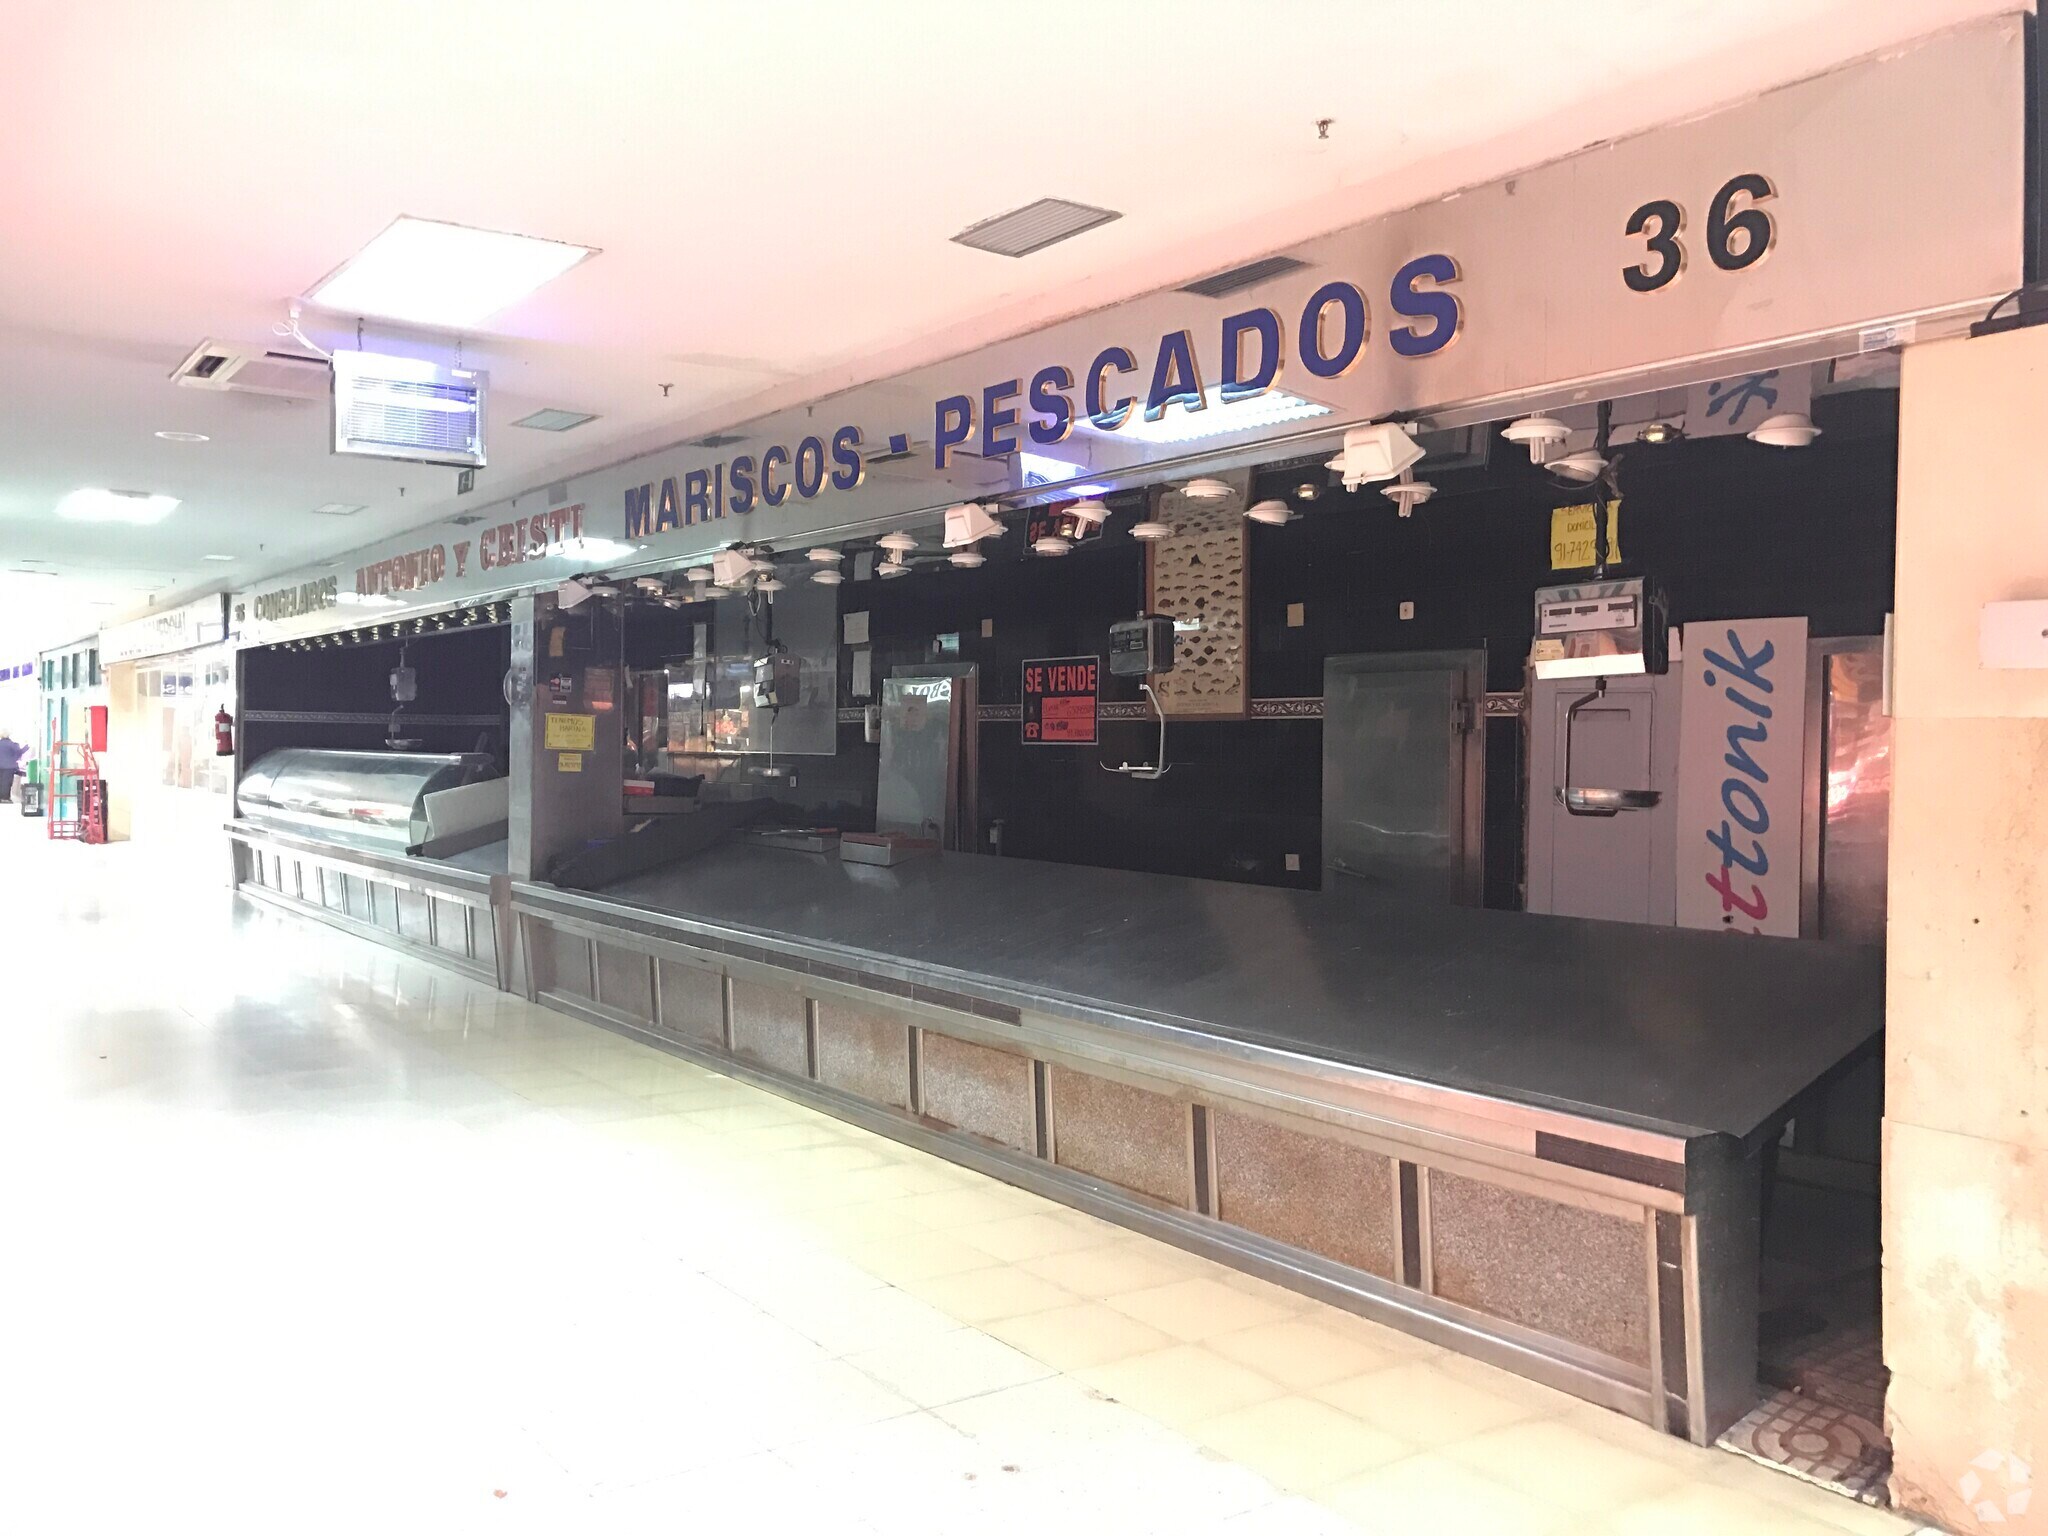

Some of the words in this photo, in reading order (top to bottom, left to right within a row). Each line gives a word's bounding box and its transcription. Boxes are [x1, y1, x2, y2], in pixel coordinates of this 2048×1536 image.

[1622, 173, 1778, 294] 36
[624, 425, 866, 540] MARISCOS
[934, 253, 1465, 470] PESCADOS
[254, 575, 338, 622] CONGELADOS
[453, 541, 471, 578] Y
[1025, 667, 1043, 693] SE
[1047, 664, 1096, 692] VENDE
[1702, 628, 1775, 935] ttonik
